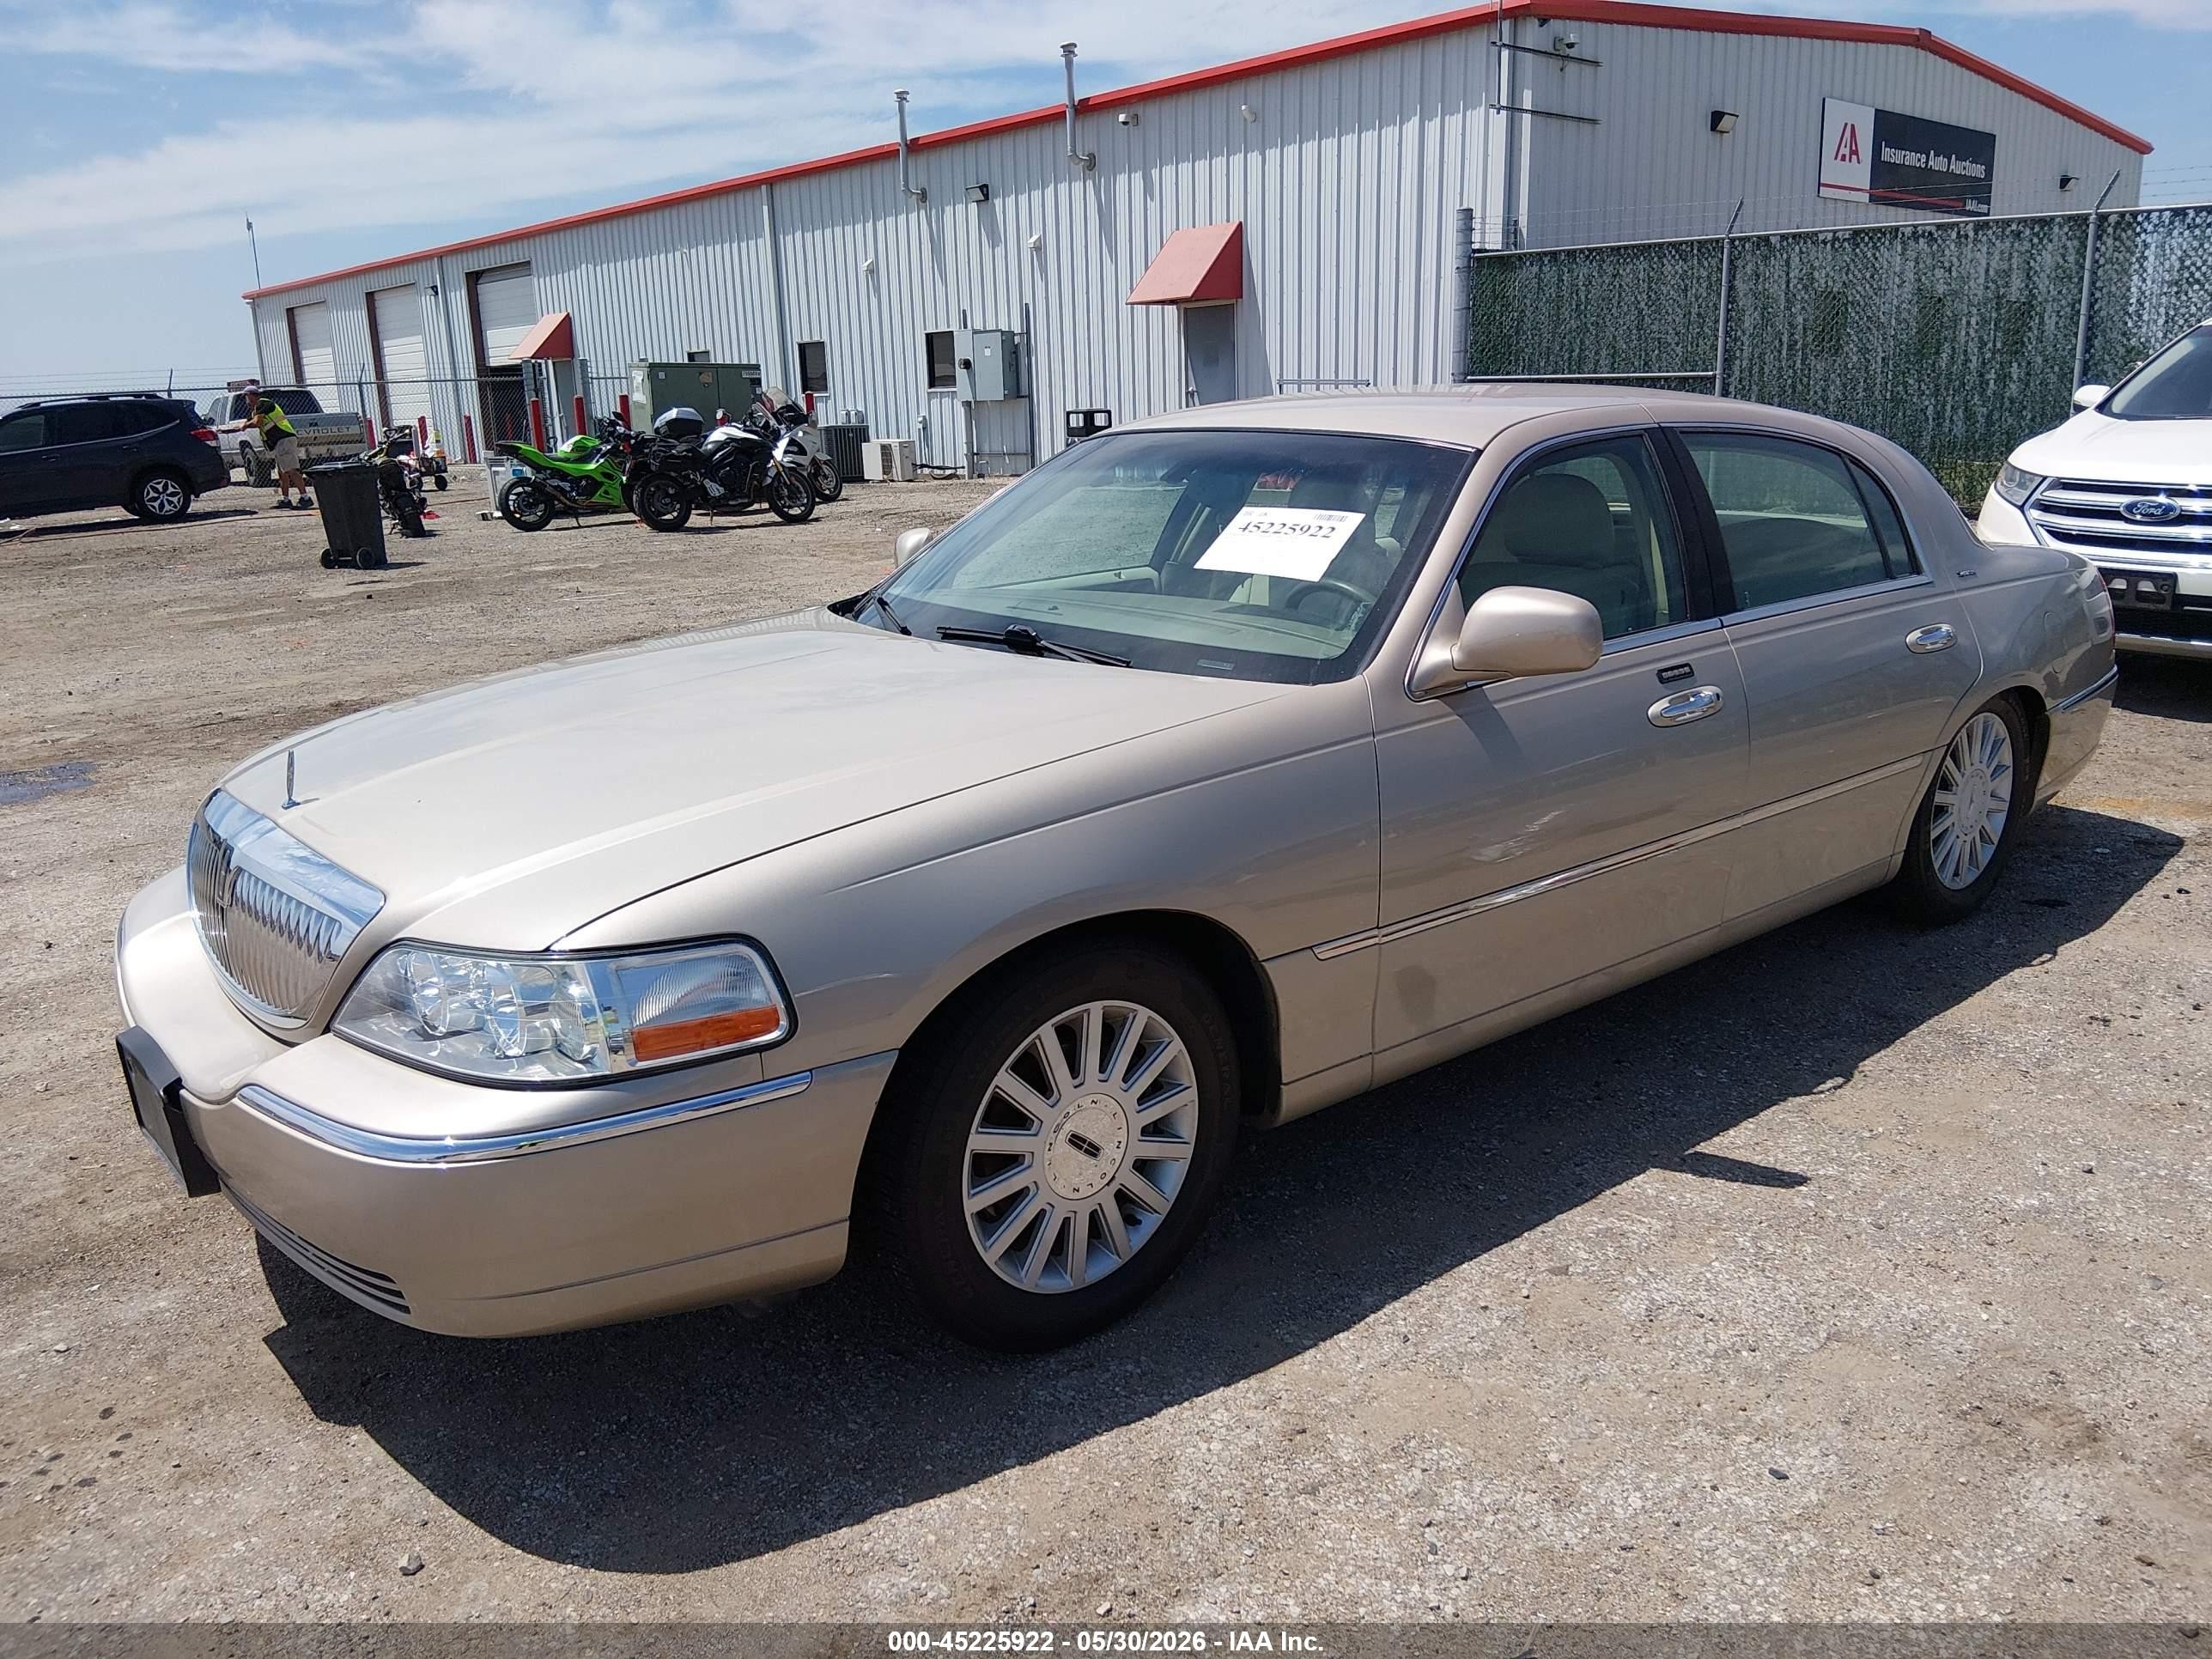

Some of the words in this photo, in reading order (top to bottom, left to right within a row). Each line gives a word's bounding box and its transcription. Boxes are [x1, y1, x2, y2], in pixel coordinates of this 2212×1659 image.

[1881, 140, 1926, 168] Insurance
[1928, 149, 1948, 173] Auto
[1949, 154, 1986, 179] Auctions
[295, 426, 351, 435] EVROLET
[2132, 501, 2166, 515] Ford
[1237, 520, 1337, 539] 45225922
